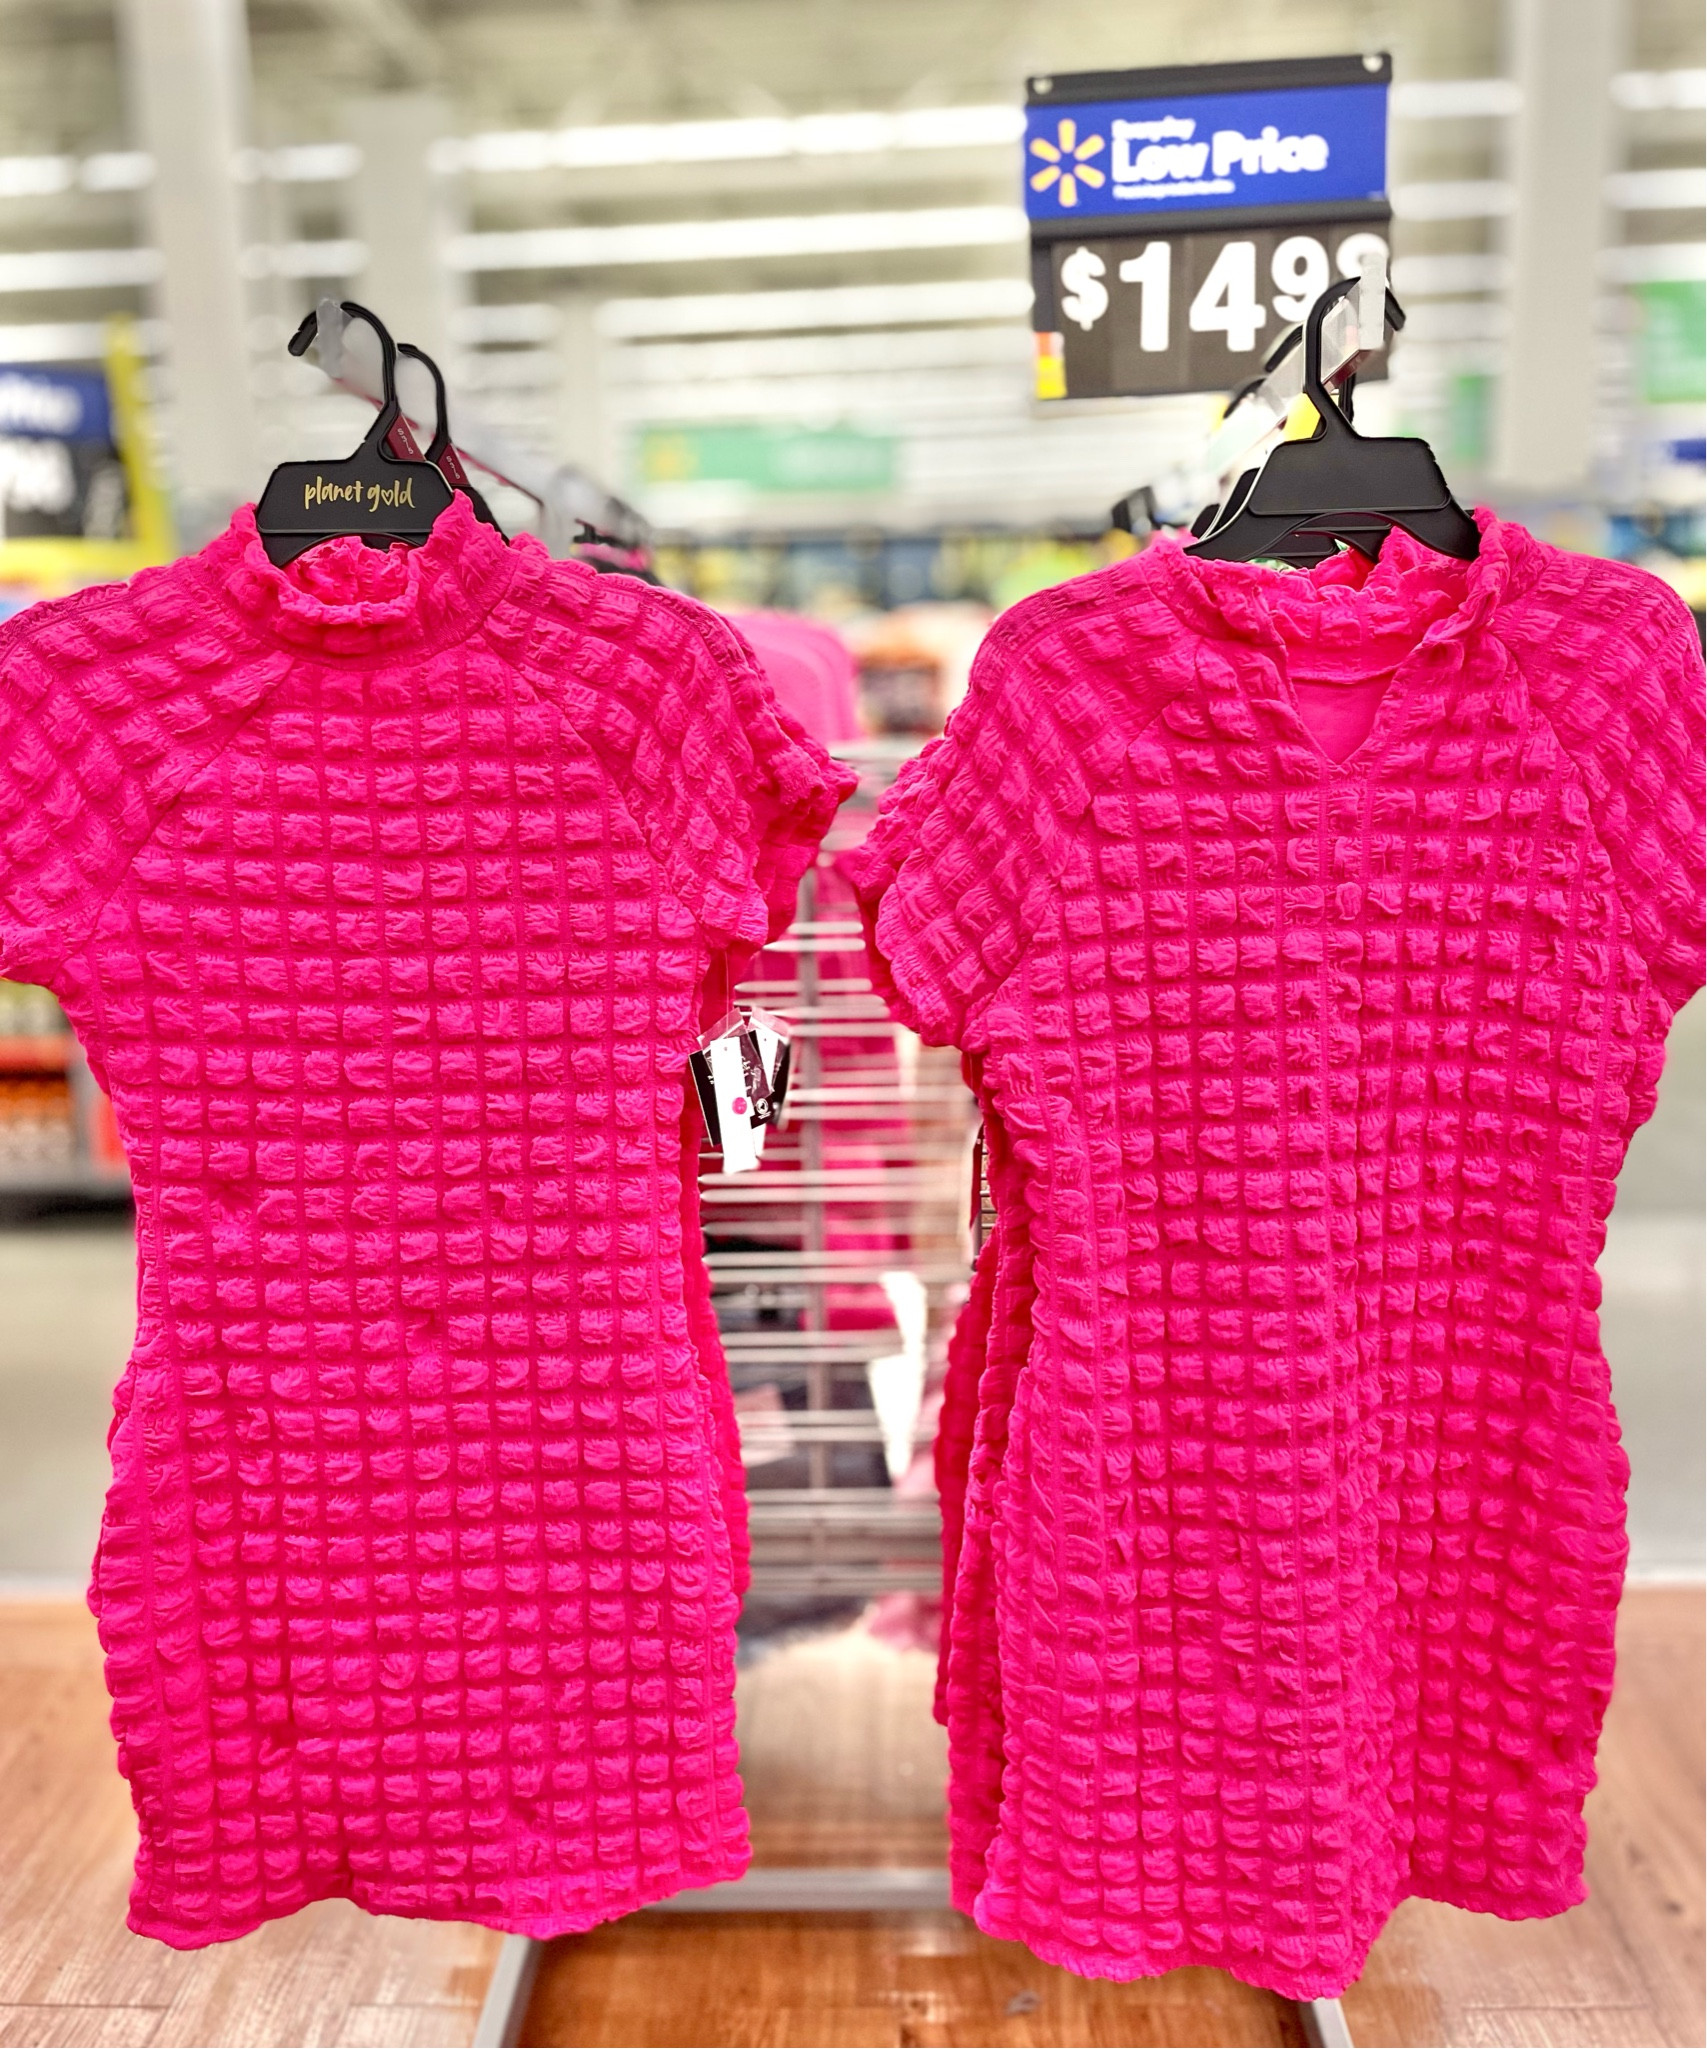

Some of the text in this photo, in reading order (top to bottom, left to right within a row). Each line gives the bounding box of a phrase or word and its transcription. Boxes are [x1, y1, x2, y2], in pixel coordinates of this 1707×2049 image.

[1111, 138, 1209, 183] Low
[1212, 126, 1329, 177] Price
[304, 475, 364, 510] planet
